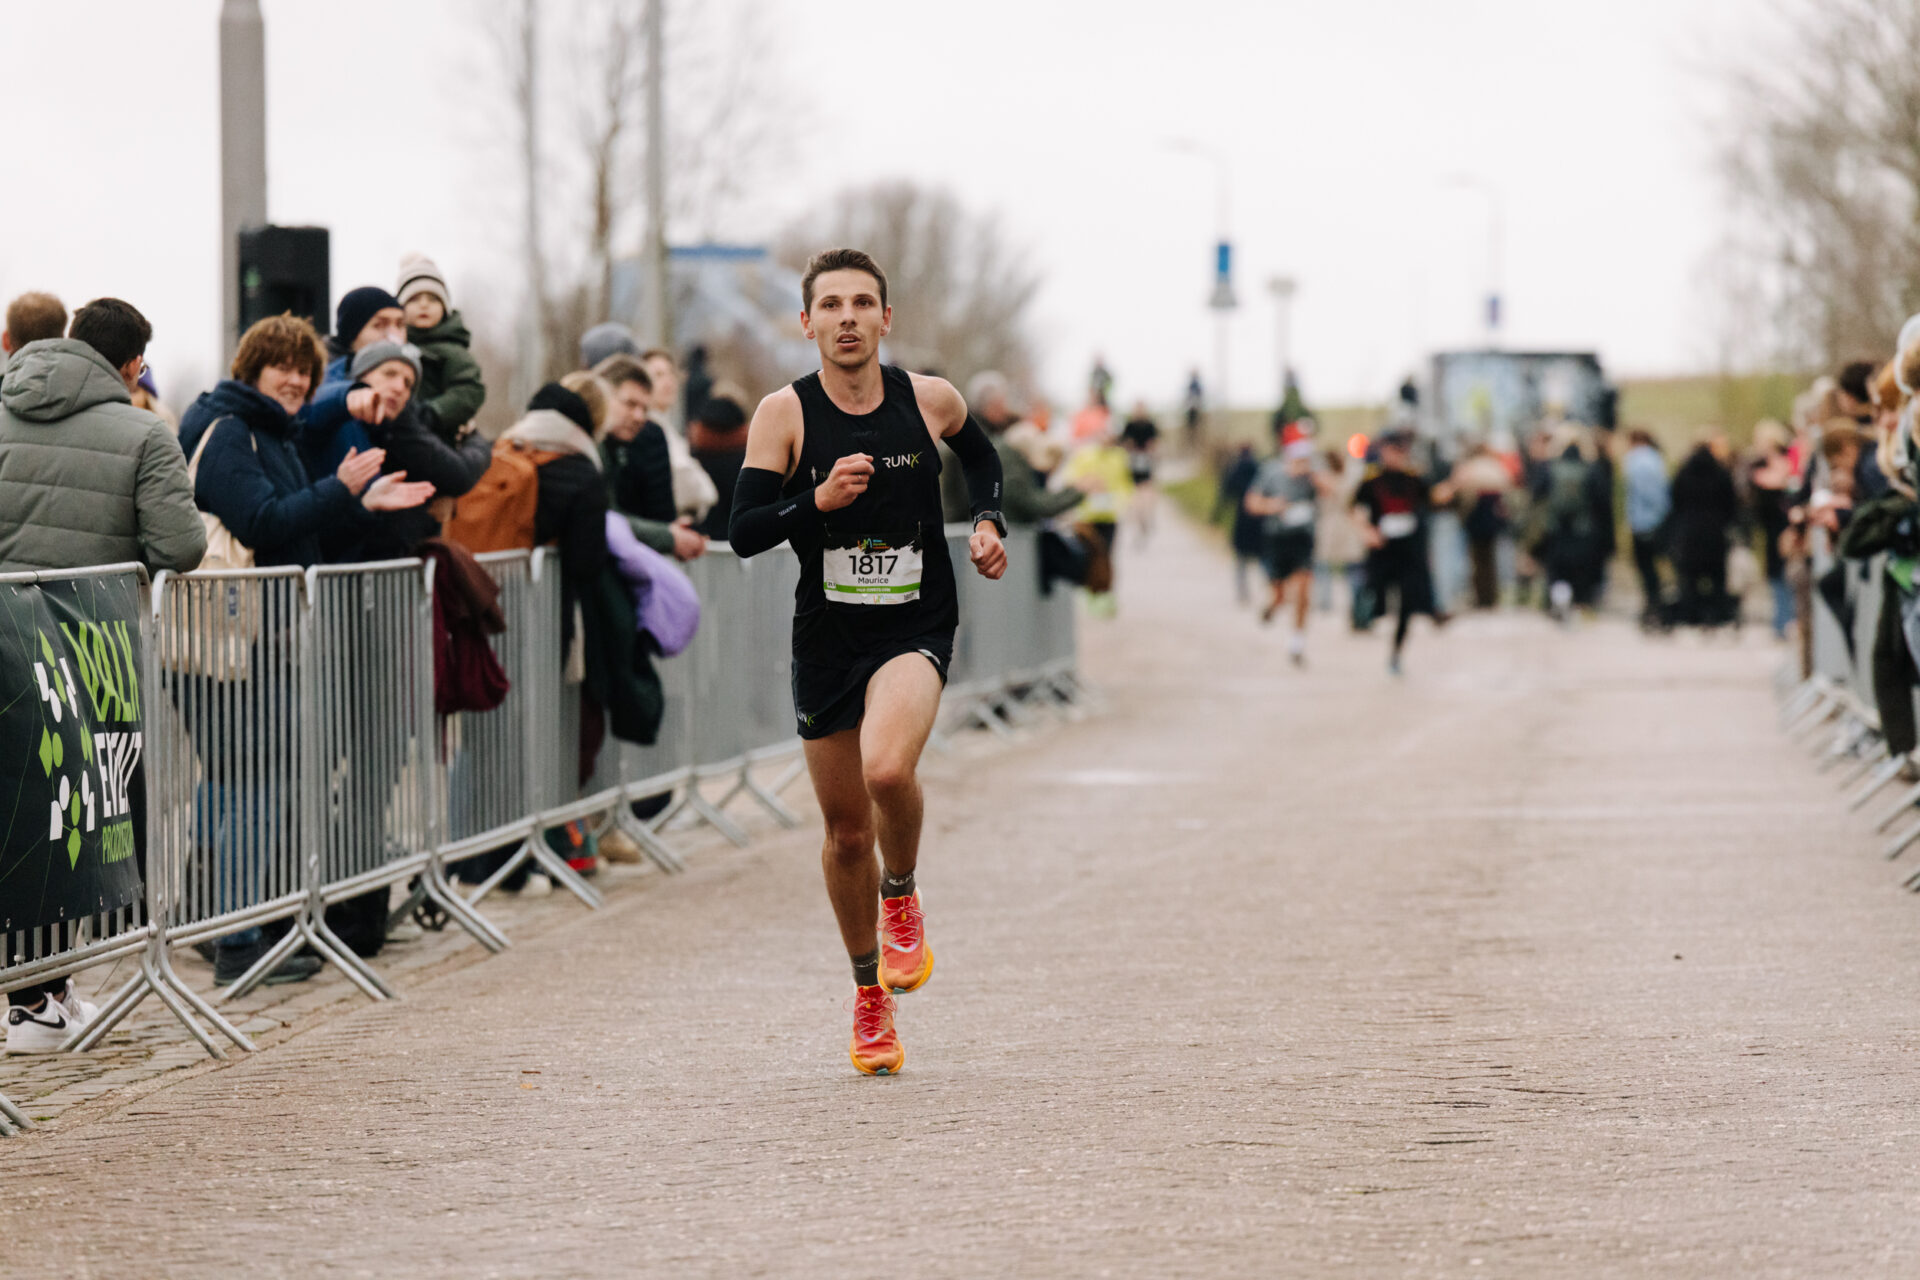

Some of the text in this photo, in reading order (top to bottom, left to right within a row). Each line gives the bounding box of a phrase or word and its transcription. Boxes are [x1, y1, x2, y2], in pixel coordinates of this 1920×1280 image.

[882, 452, 923, 468] RUNX
[848, 554, 898, 575] 1817
[857, 577, 889, 585] Maurice
